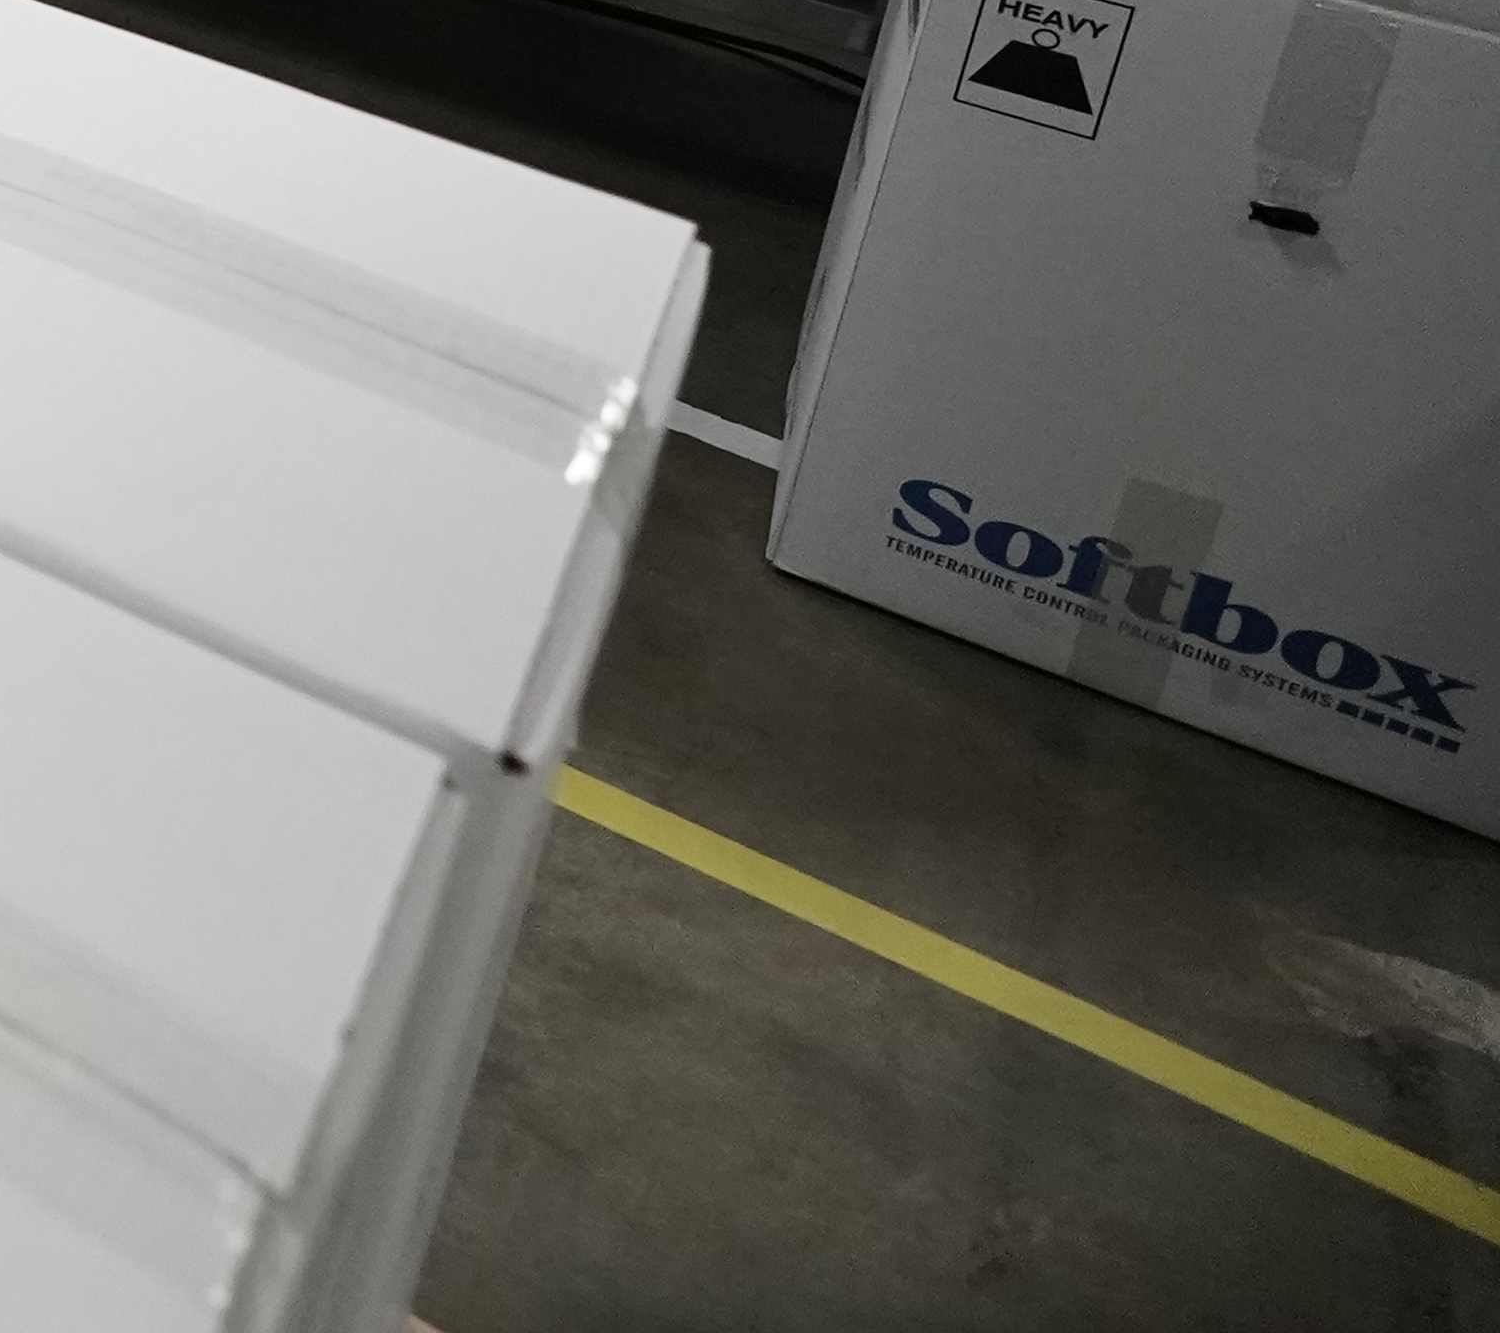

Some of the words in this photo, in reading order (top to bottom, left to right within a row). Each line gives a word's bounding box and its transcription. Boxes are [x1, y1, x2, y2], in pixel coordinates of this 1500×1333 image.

[884, 534, 1018, 598] TEMPERATURE
[1022, 586, 1109, 629] CONTROL
[1115, 617, 1233, 673] PACKAGING
[1237, 663, 1336, 710] SYSTEMS
[891, 478, 1477, 734] Softbox
